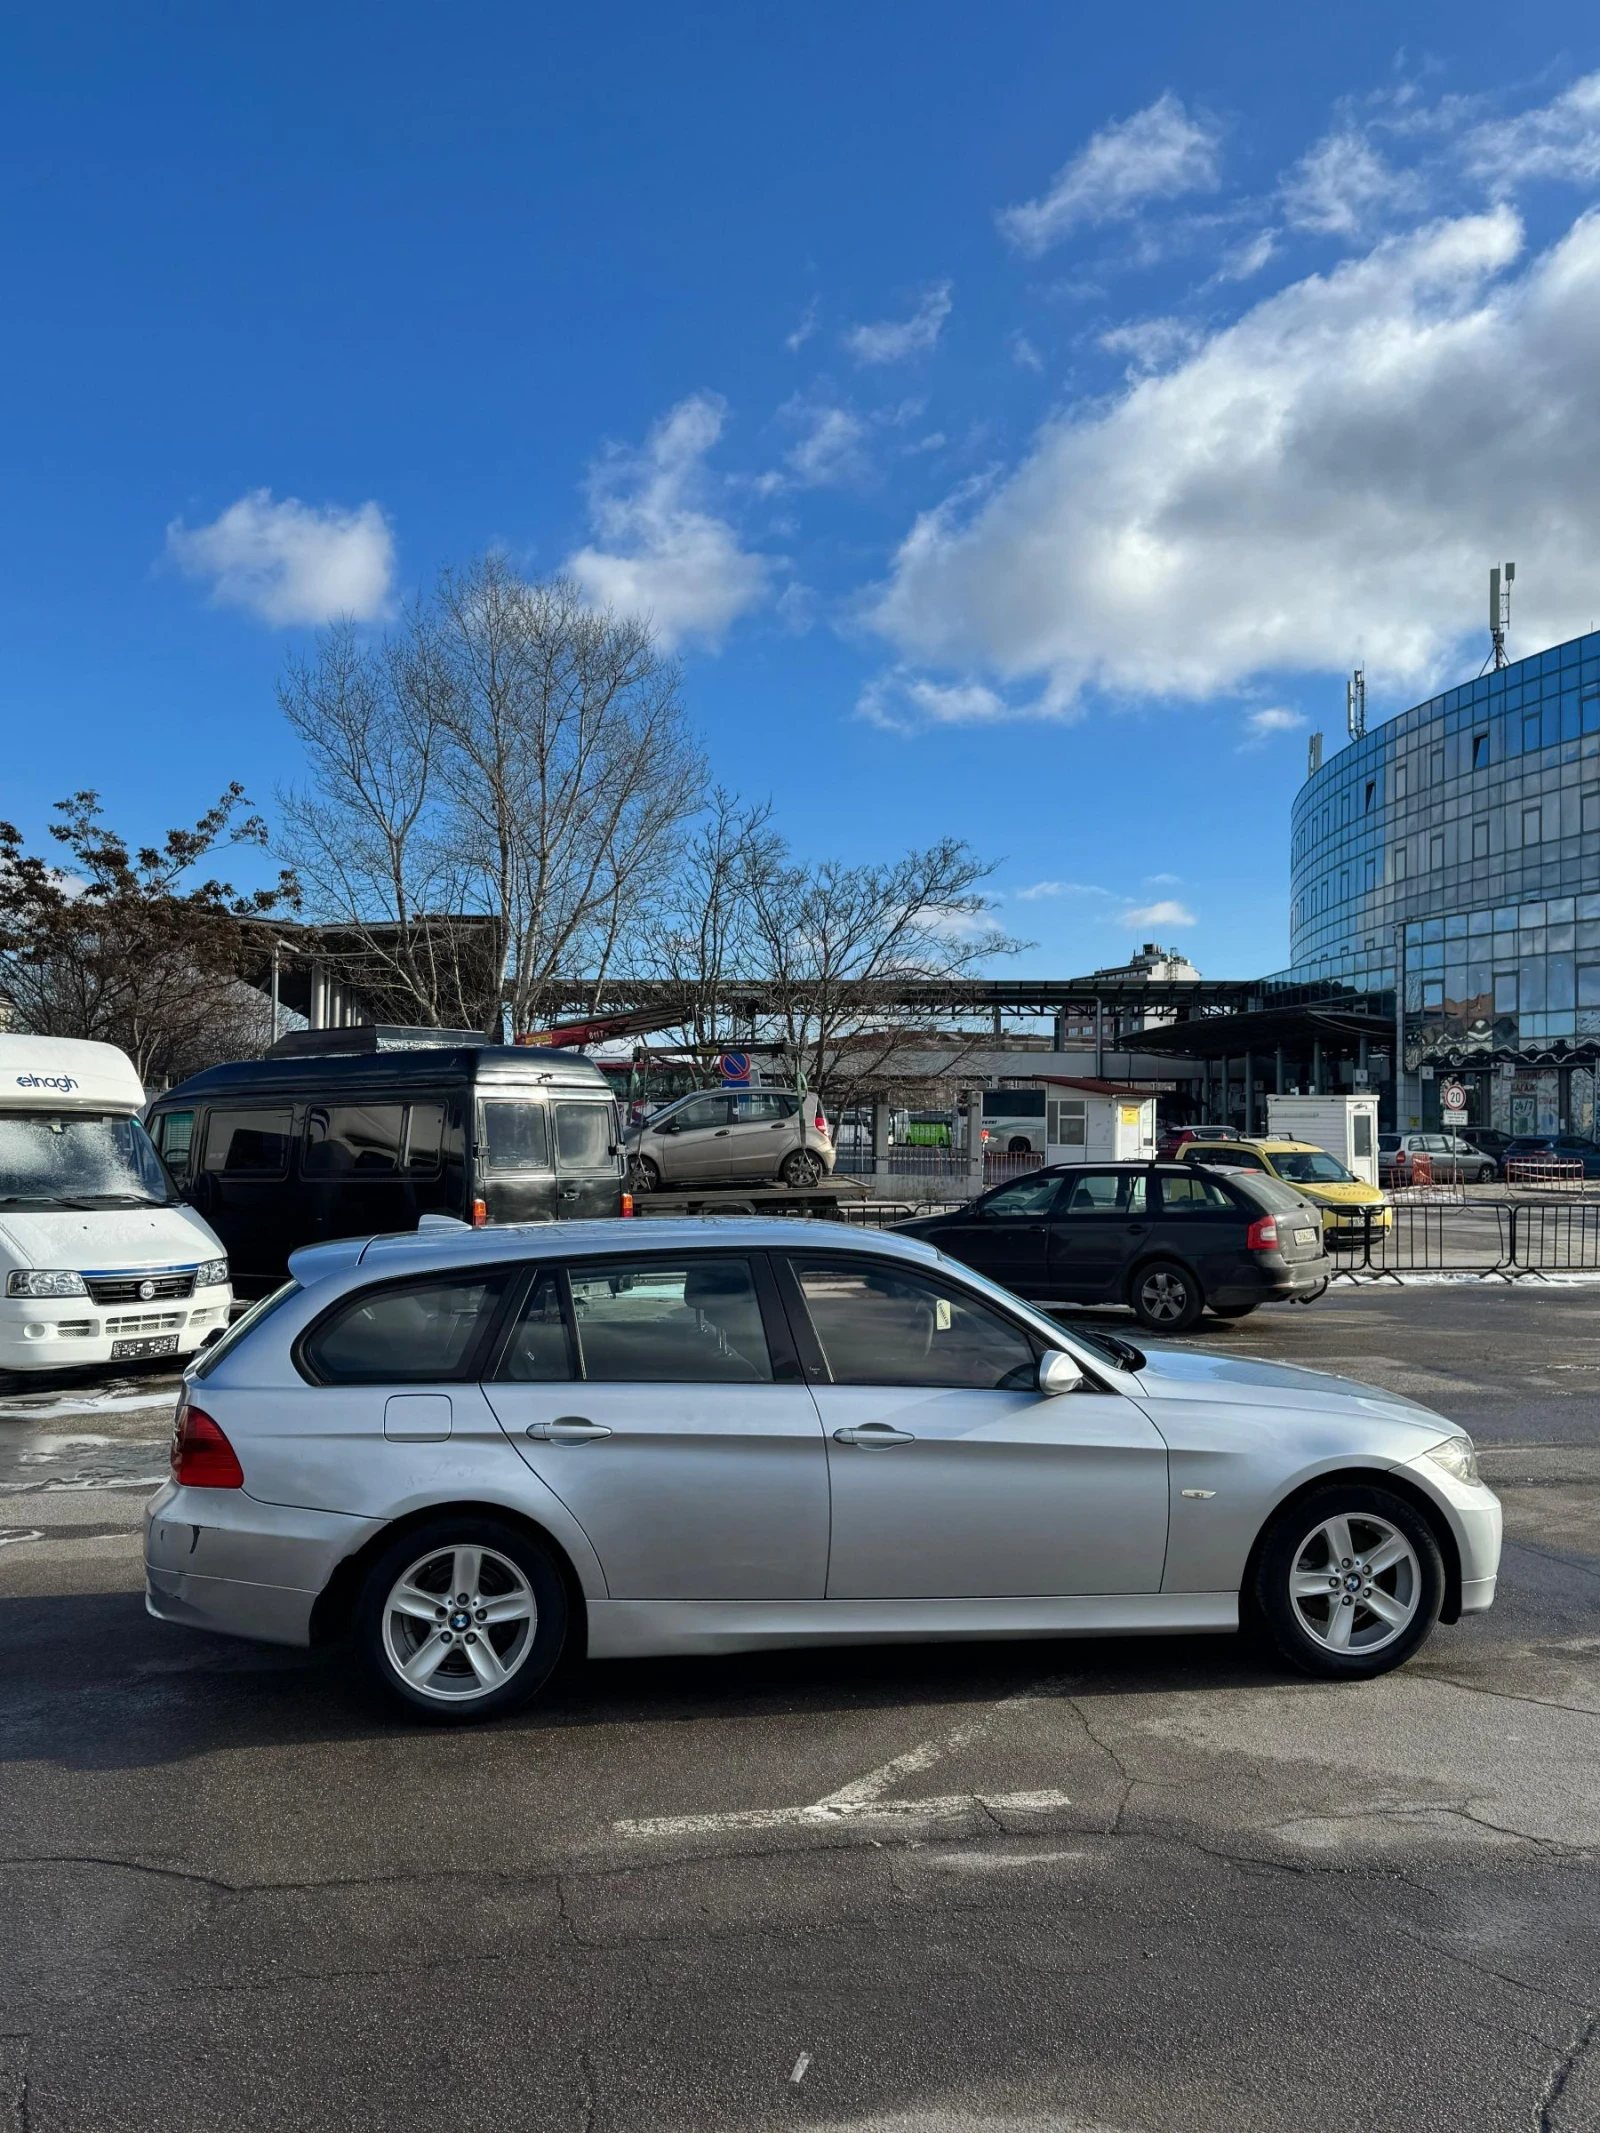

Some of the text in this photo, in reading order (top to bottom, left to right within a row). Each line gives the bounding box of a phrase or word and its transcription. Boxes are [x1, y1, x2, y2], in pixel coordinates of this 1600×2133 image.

[16, 1073, 79, 1092] elnagh
[1450, 1091, 1461, 1103] 20
[1514, 1100, 1534, 1112] 24/7
